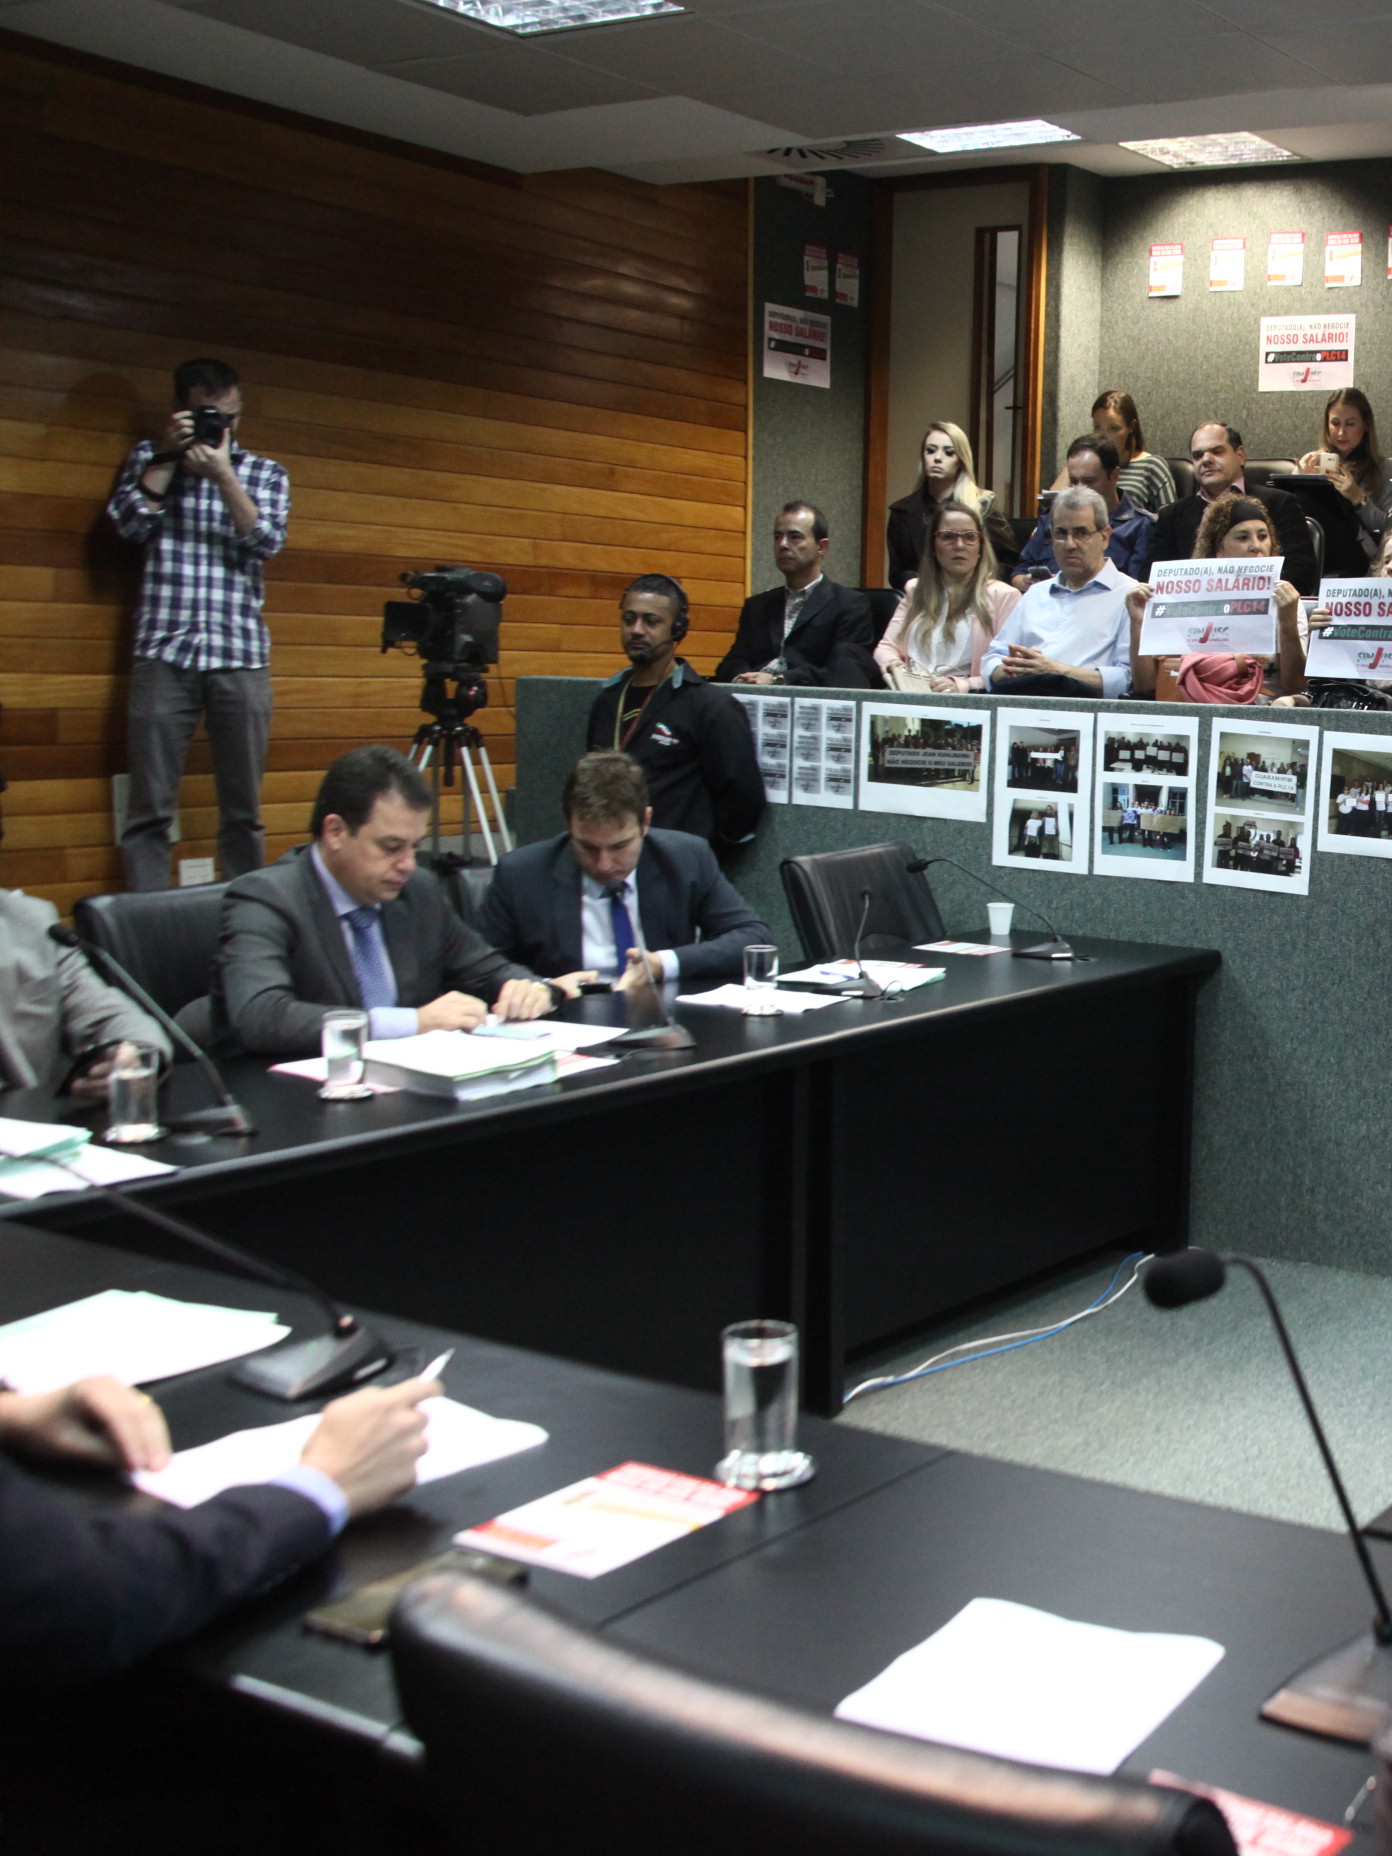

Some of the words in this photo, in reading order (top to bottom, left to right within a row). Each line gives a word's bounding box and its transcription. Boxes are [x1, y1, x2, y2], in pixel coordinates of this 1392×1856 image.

[1266, 334, 1299, 345] NOSSO
[1302, 330, 1349, 344] SALÁRIO!
[1157, 566, 1214, 577] DEPUTADO(A),
[1217, 564, 1234, 574] NÃO
[1237, 564, 1275, 574] NEGOCIE
[1155, 579, 1202, 595] NOSSO
[1206, 575, 1272, 592] SALÁRIO!
[1326, 588, 1385, 599] DEPUTADO(A),
[1325, 601, 1372, 617] NOSSO
